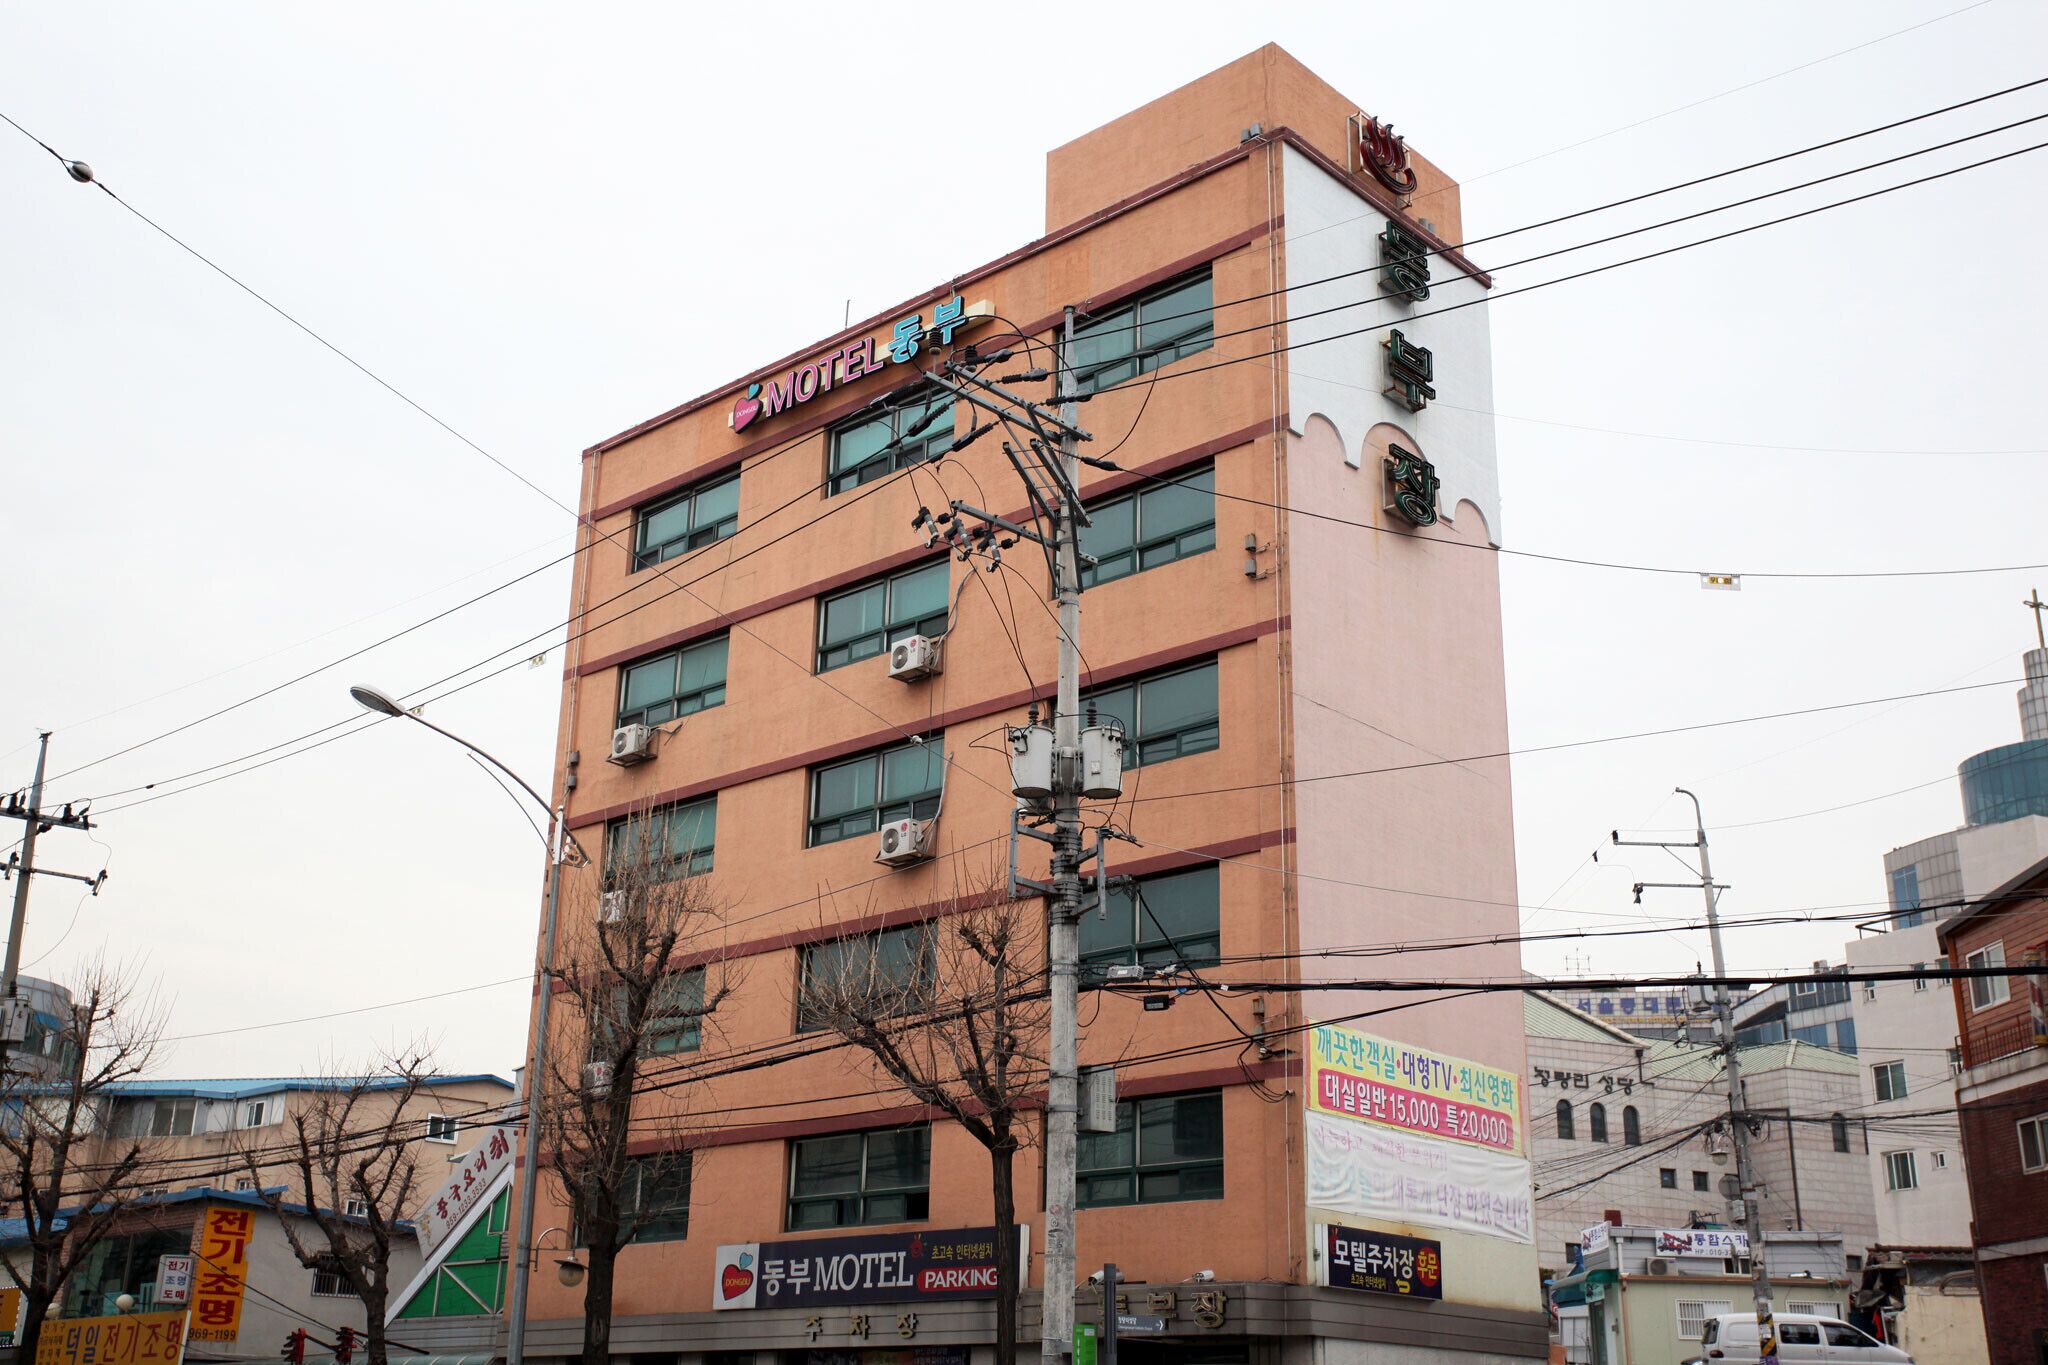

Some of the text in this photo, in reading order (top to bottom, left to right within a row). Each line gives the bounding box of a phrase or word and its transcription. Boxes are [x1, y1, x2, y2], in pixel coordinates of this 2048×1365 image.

[766, 295, 967, 418] MOTEL 동부
[1534, 1066, 1633, 1095] 청량리 성당
[168, 1260, 189, 1271] 전기
[931, 1246, 955, 1260] 초고속
[1334, 1239, 1438, 1279] 모텔주차장 후문
[165, 1275, 187, 1286] 조명
[198, 1210, 249, 1326] 전기조명
[762, 1251, 914, 1297] 동부 MOTEL
[924, 1267, 999, 1290] PARKING
[163, 1289, 185, 1300] 도매
[66, 1318, 183, 1365] 덕일 전기조명
[190, 1327, 236, 1341] 969-1199
